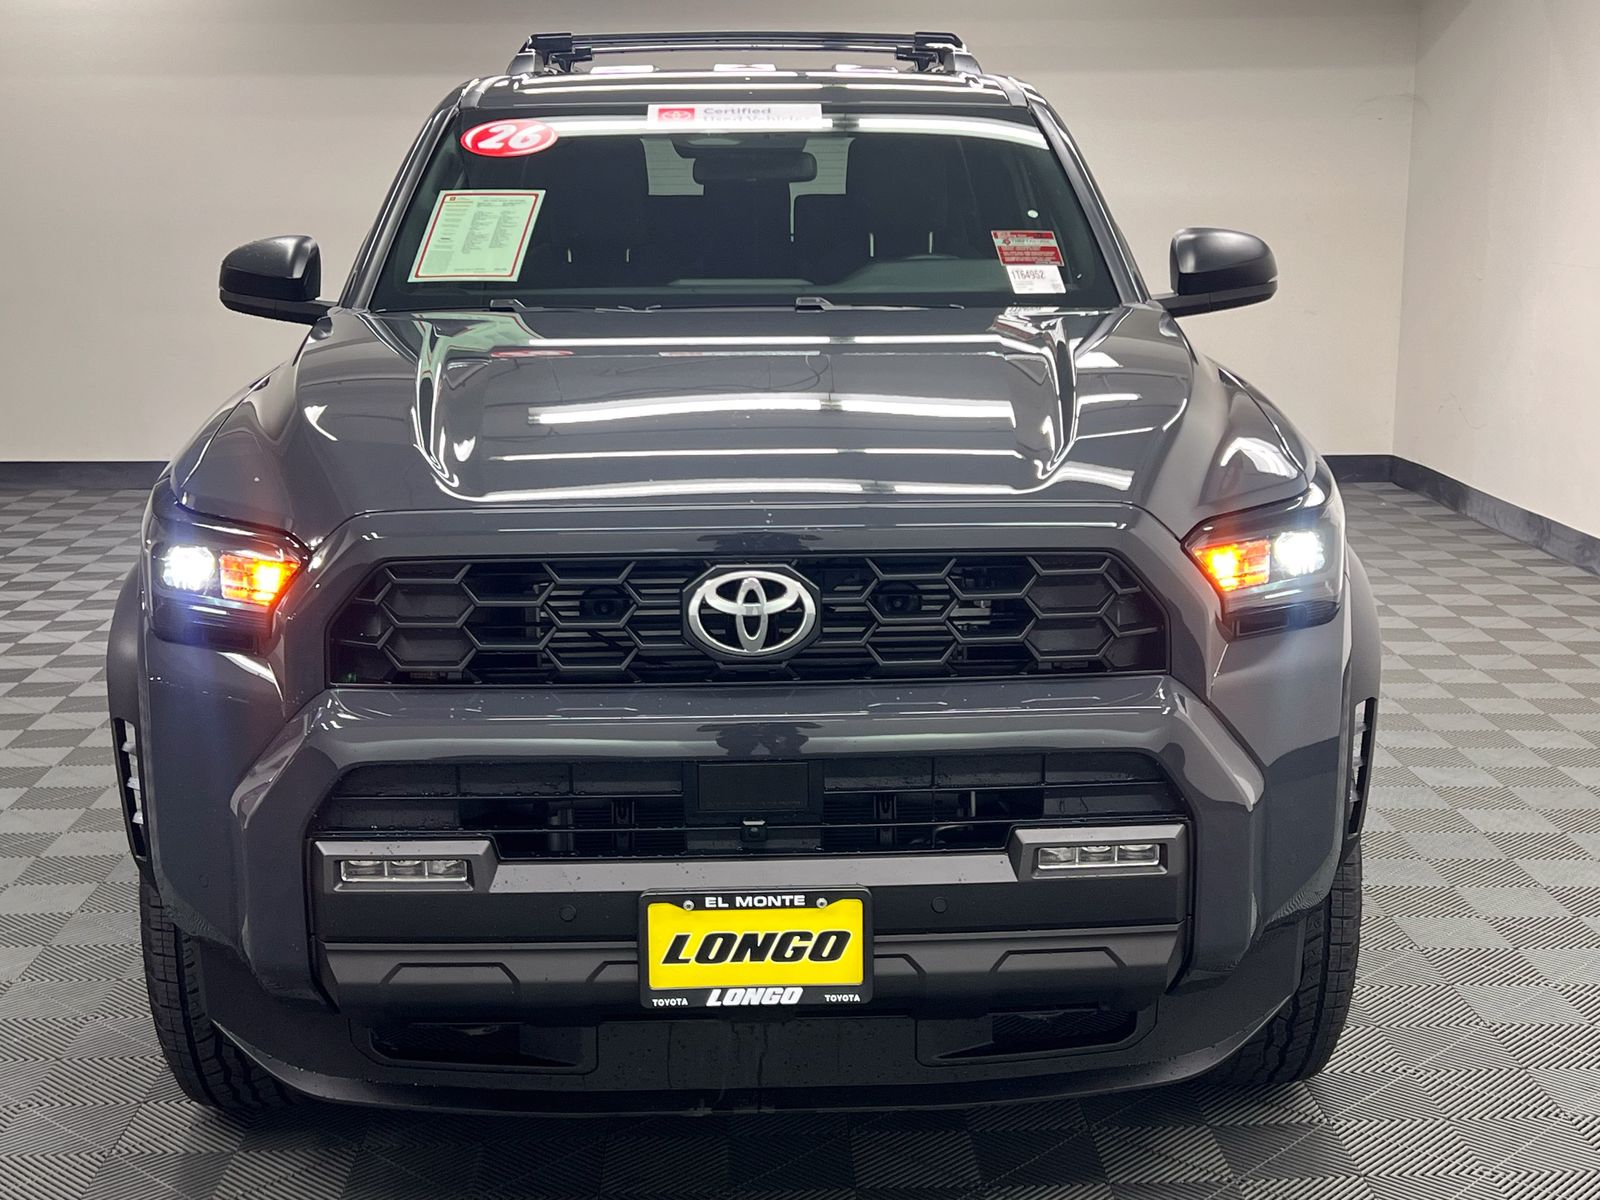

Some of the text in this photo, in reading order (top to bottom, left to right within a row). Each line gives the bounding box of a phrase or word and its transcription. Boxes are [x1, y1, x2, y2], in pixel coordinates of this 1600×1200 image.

[478, 124, 546, 149] 26
[705, 895, 806, 908] EL MONTE
[661, 930, 852, 965] LONGO
[652, 998, 688, 1007] TOYOTA
[706, 987, 804, 1007] LONGO
[824, 994, 861, 1002] TOYOTA
